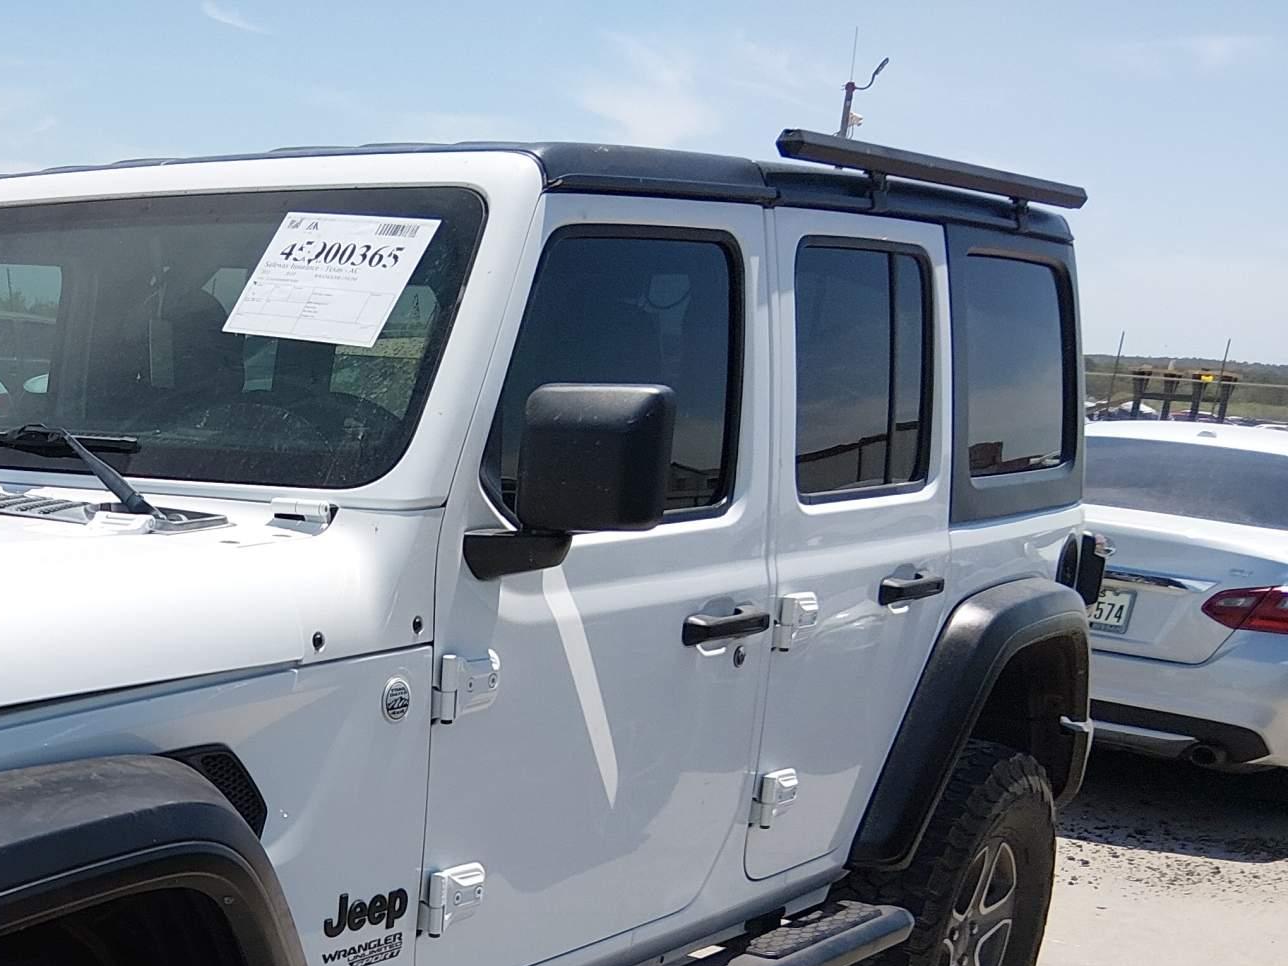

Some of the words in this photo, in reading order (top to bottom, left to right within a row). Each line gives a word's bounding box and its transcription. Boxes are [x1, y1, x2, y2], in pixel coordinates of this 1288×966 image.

[1088, 601, 1125, 623] 574
[324, 888, 408, 938] Jeep
[322, 932, 403, 964] WRANGLER
[347, 941, 403, 962] UNLIMITED
